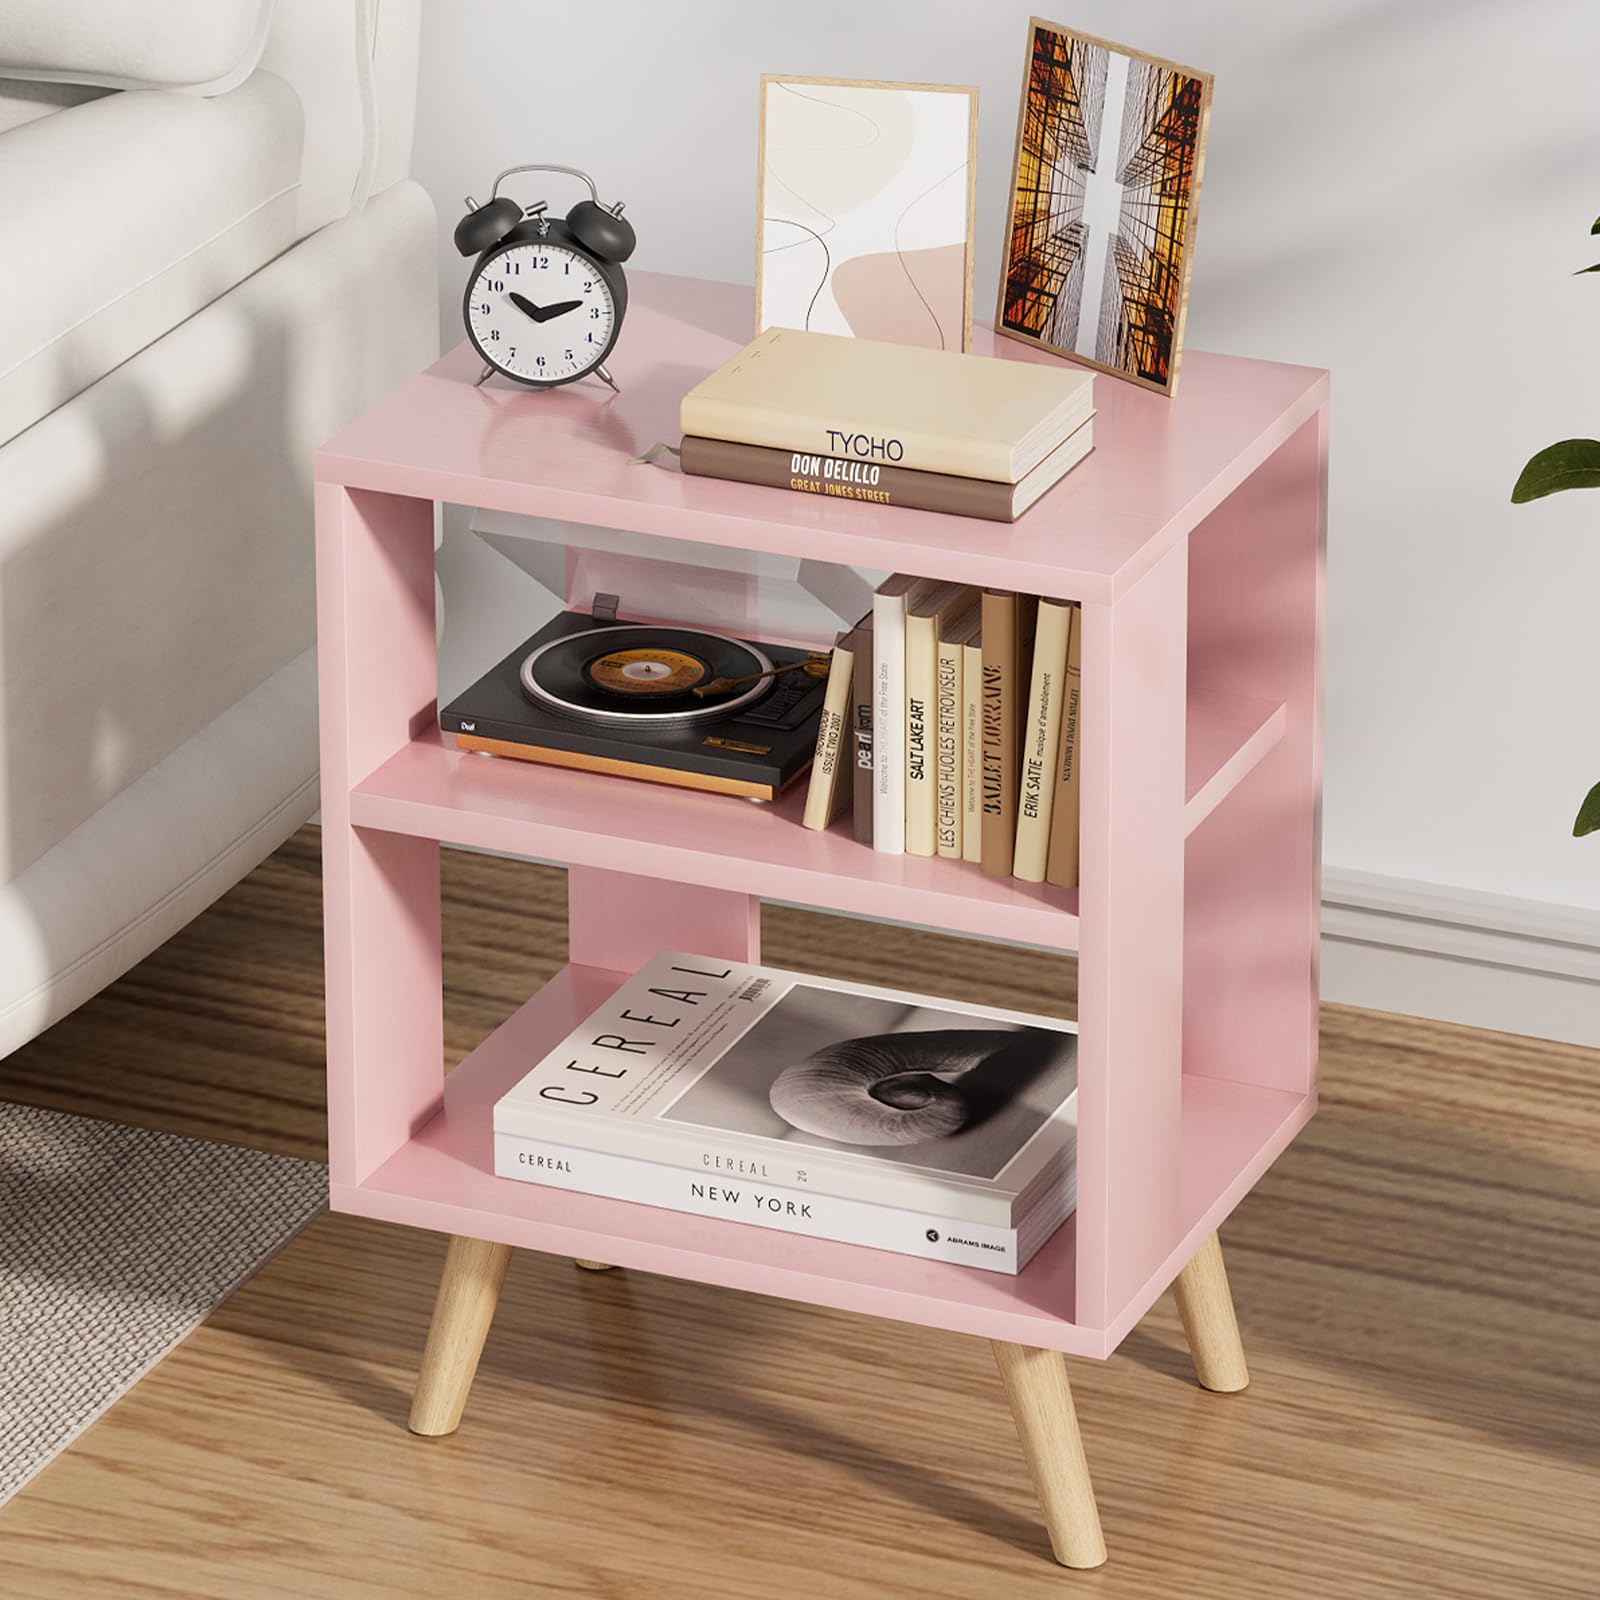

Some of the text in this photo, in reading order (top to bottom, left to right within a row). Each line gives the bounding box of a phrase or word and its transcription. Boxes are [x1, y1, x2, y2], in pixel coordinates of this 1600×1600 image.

[505, 262, 520, 275] 11
[531, 257, 549, 270] 12
[563, 263, 570, 275] 1
[487, 280, 504, 292] 10
[583, 281, 592, 293] 2
[481, 303, 491, 315] 9
[590, 308, 599, 319] 3
[490, 330, 500, 341] 8
[584, 332, 593, 343] 4
[508, 347, 517, 358] 7
[536, 356, 546, 367] 6
[564, 349, 573, 361] 5
[826, 430, 904, 461] TYCHO
[791, 454, 880, 486] DON DELILLO
[790, 478, 890, 504] GREAT JONES STREET
[822, 713, 841, 775] ISSUE TWO 2007
[910, 697, 924, 780] SALT LAKE ART
[983, 664, 1002, 815] BALLET LORRAINE
[1036, 728, 1046, 757] musique
[854, 730, 874, 770] pearl
[939, 658, 955, 848] LES CHIENS HUOLES RETROVISEUR
[1027, 758, 1043, 791] SATIE
[1024, 792, 1039, 818] ERIK
[539, 966, 732, 1106] CEREAL
[519, 1152, 572, 1173] CEREAL
[703, 1153, 767, 1177] CEREAL
[691, 1183, 812, 1218] NEW YORK
[947, 1236, 980, 1248] ABRAMS
[981, 1242, 1006, 1253] IMAGE
